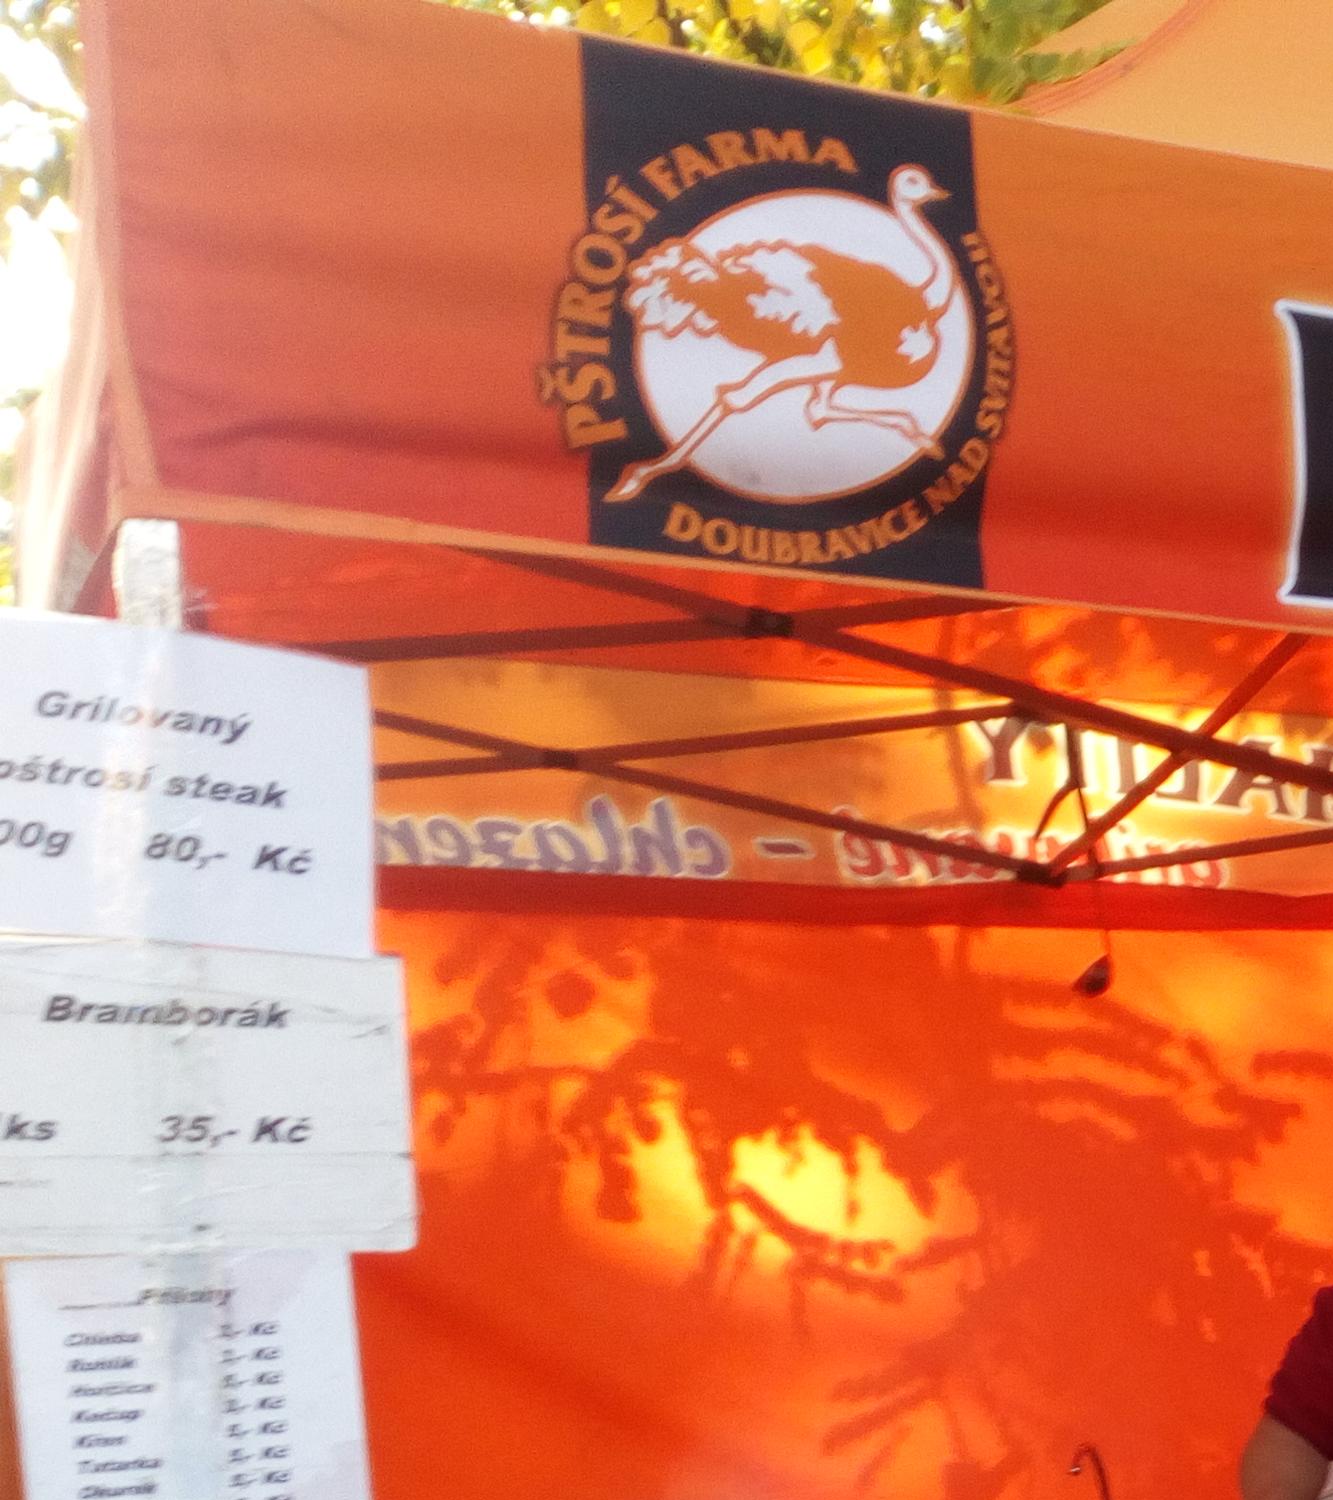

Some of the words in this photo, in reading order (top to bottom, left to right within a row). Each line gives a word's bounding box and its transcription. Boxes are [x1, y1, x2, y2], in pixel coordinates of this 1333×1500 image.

[535, 174, 655, 450] PŠTROSÍ
[641, 129, 859, 199] FARMA
[663, 499, 929, 565] DOUBRAVICE
[924, 438, 991, 518] NAD
[36, 691, 254, 745] Grilovaný
[163, 771, 289, 809] steak
[144, 834, 227, 868] 80,-
[251, 844, 314, 875] Kč
[42, 994, 293, 1029] Bramborák
[4, 1114, 59, 1141] ks
[156, 1115, 238, 1147] 35,-
[251, 1117, 313, 1144] Kč
